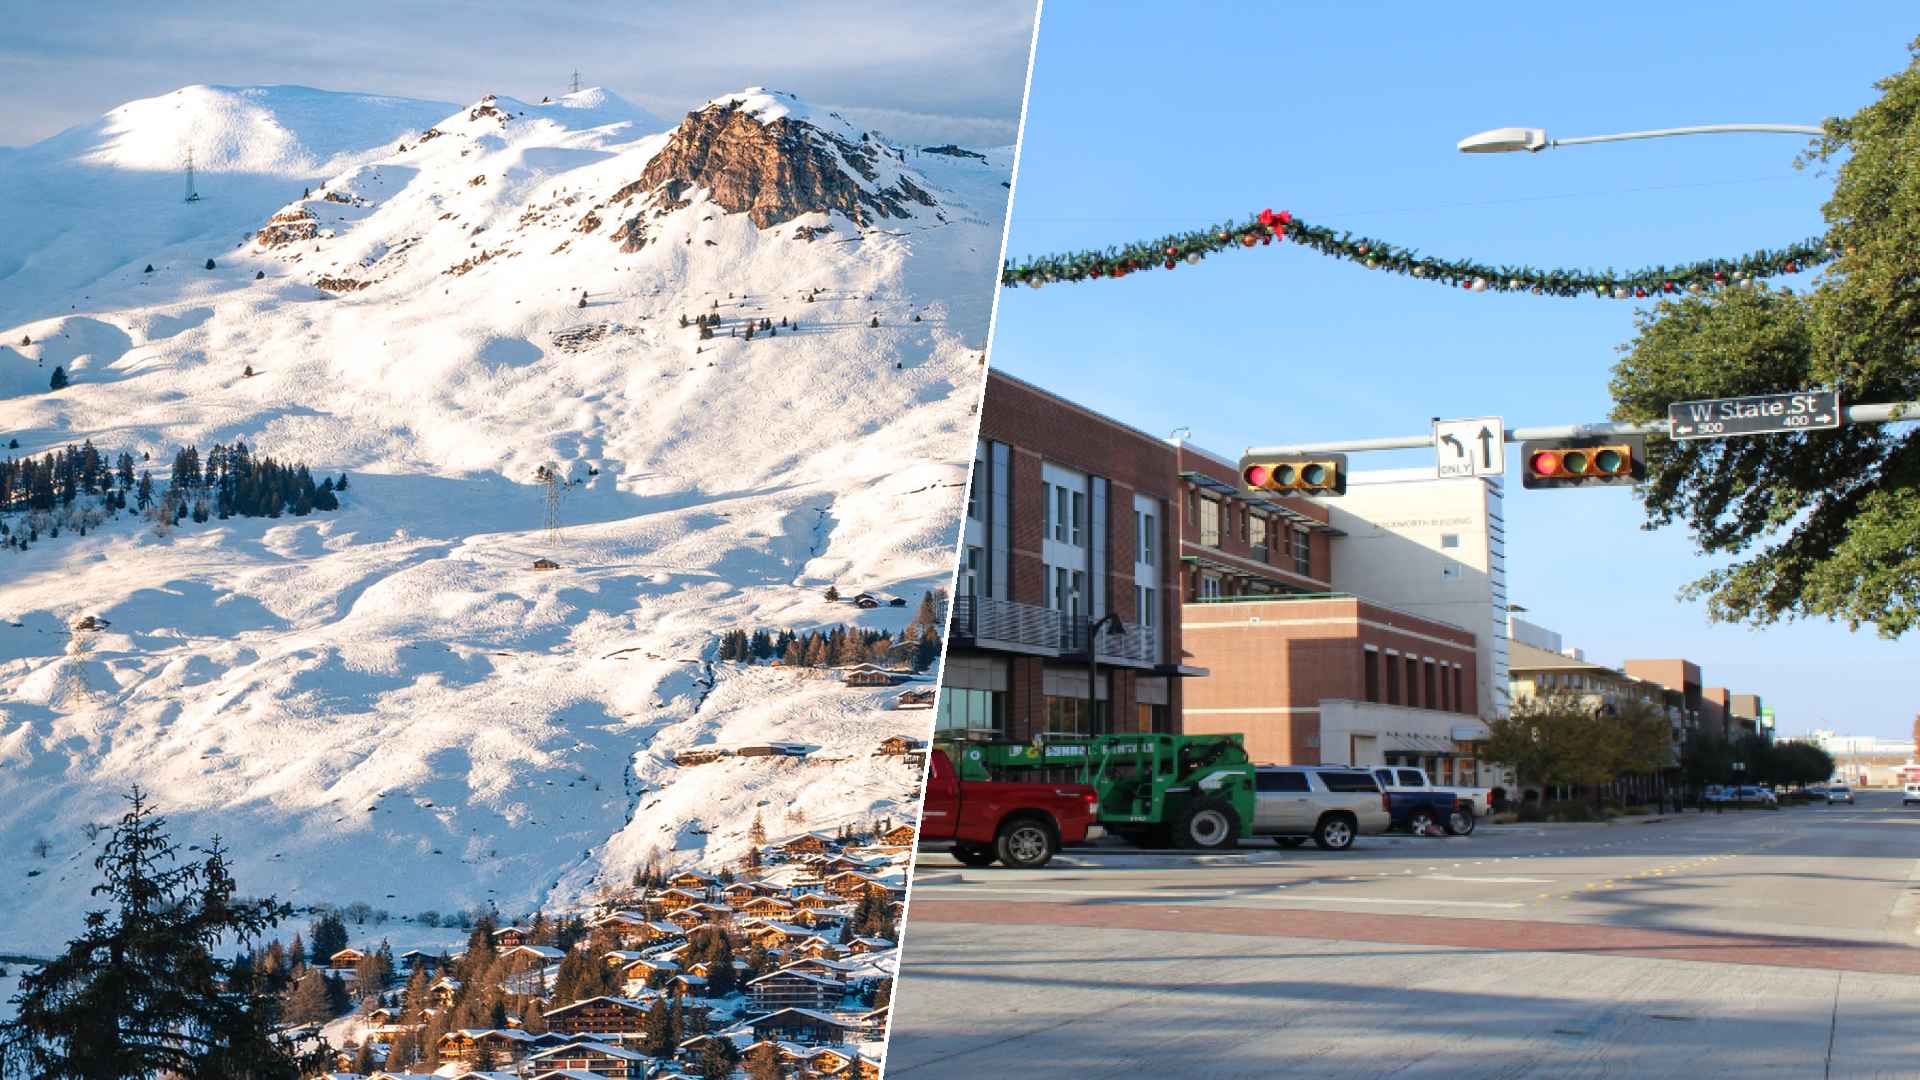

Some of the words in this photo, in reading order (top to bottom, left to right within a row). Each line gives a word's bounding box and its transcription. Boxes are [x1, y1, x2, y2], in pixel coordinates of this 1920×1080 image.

[1690, 404, 1712, 422] W
[1720, 400, 1784, 420] State
[1791, 395, 1817, 415] St
[1783, 415, 1809, 426] 400
[1698, 422, 1724, 434] 500
[1440, 463, 1471, 474] ONLY
